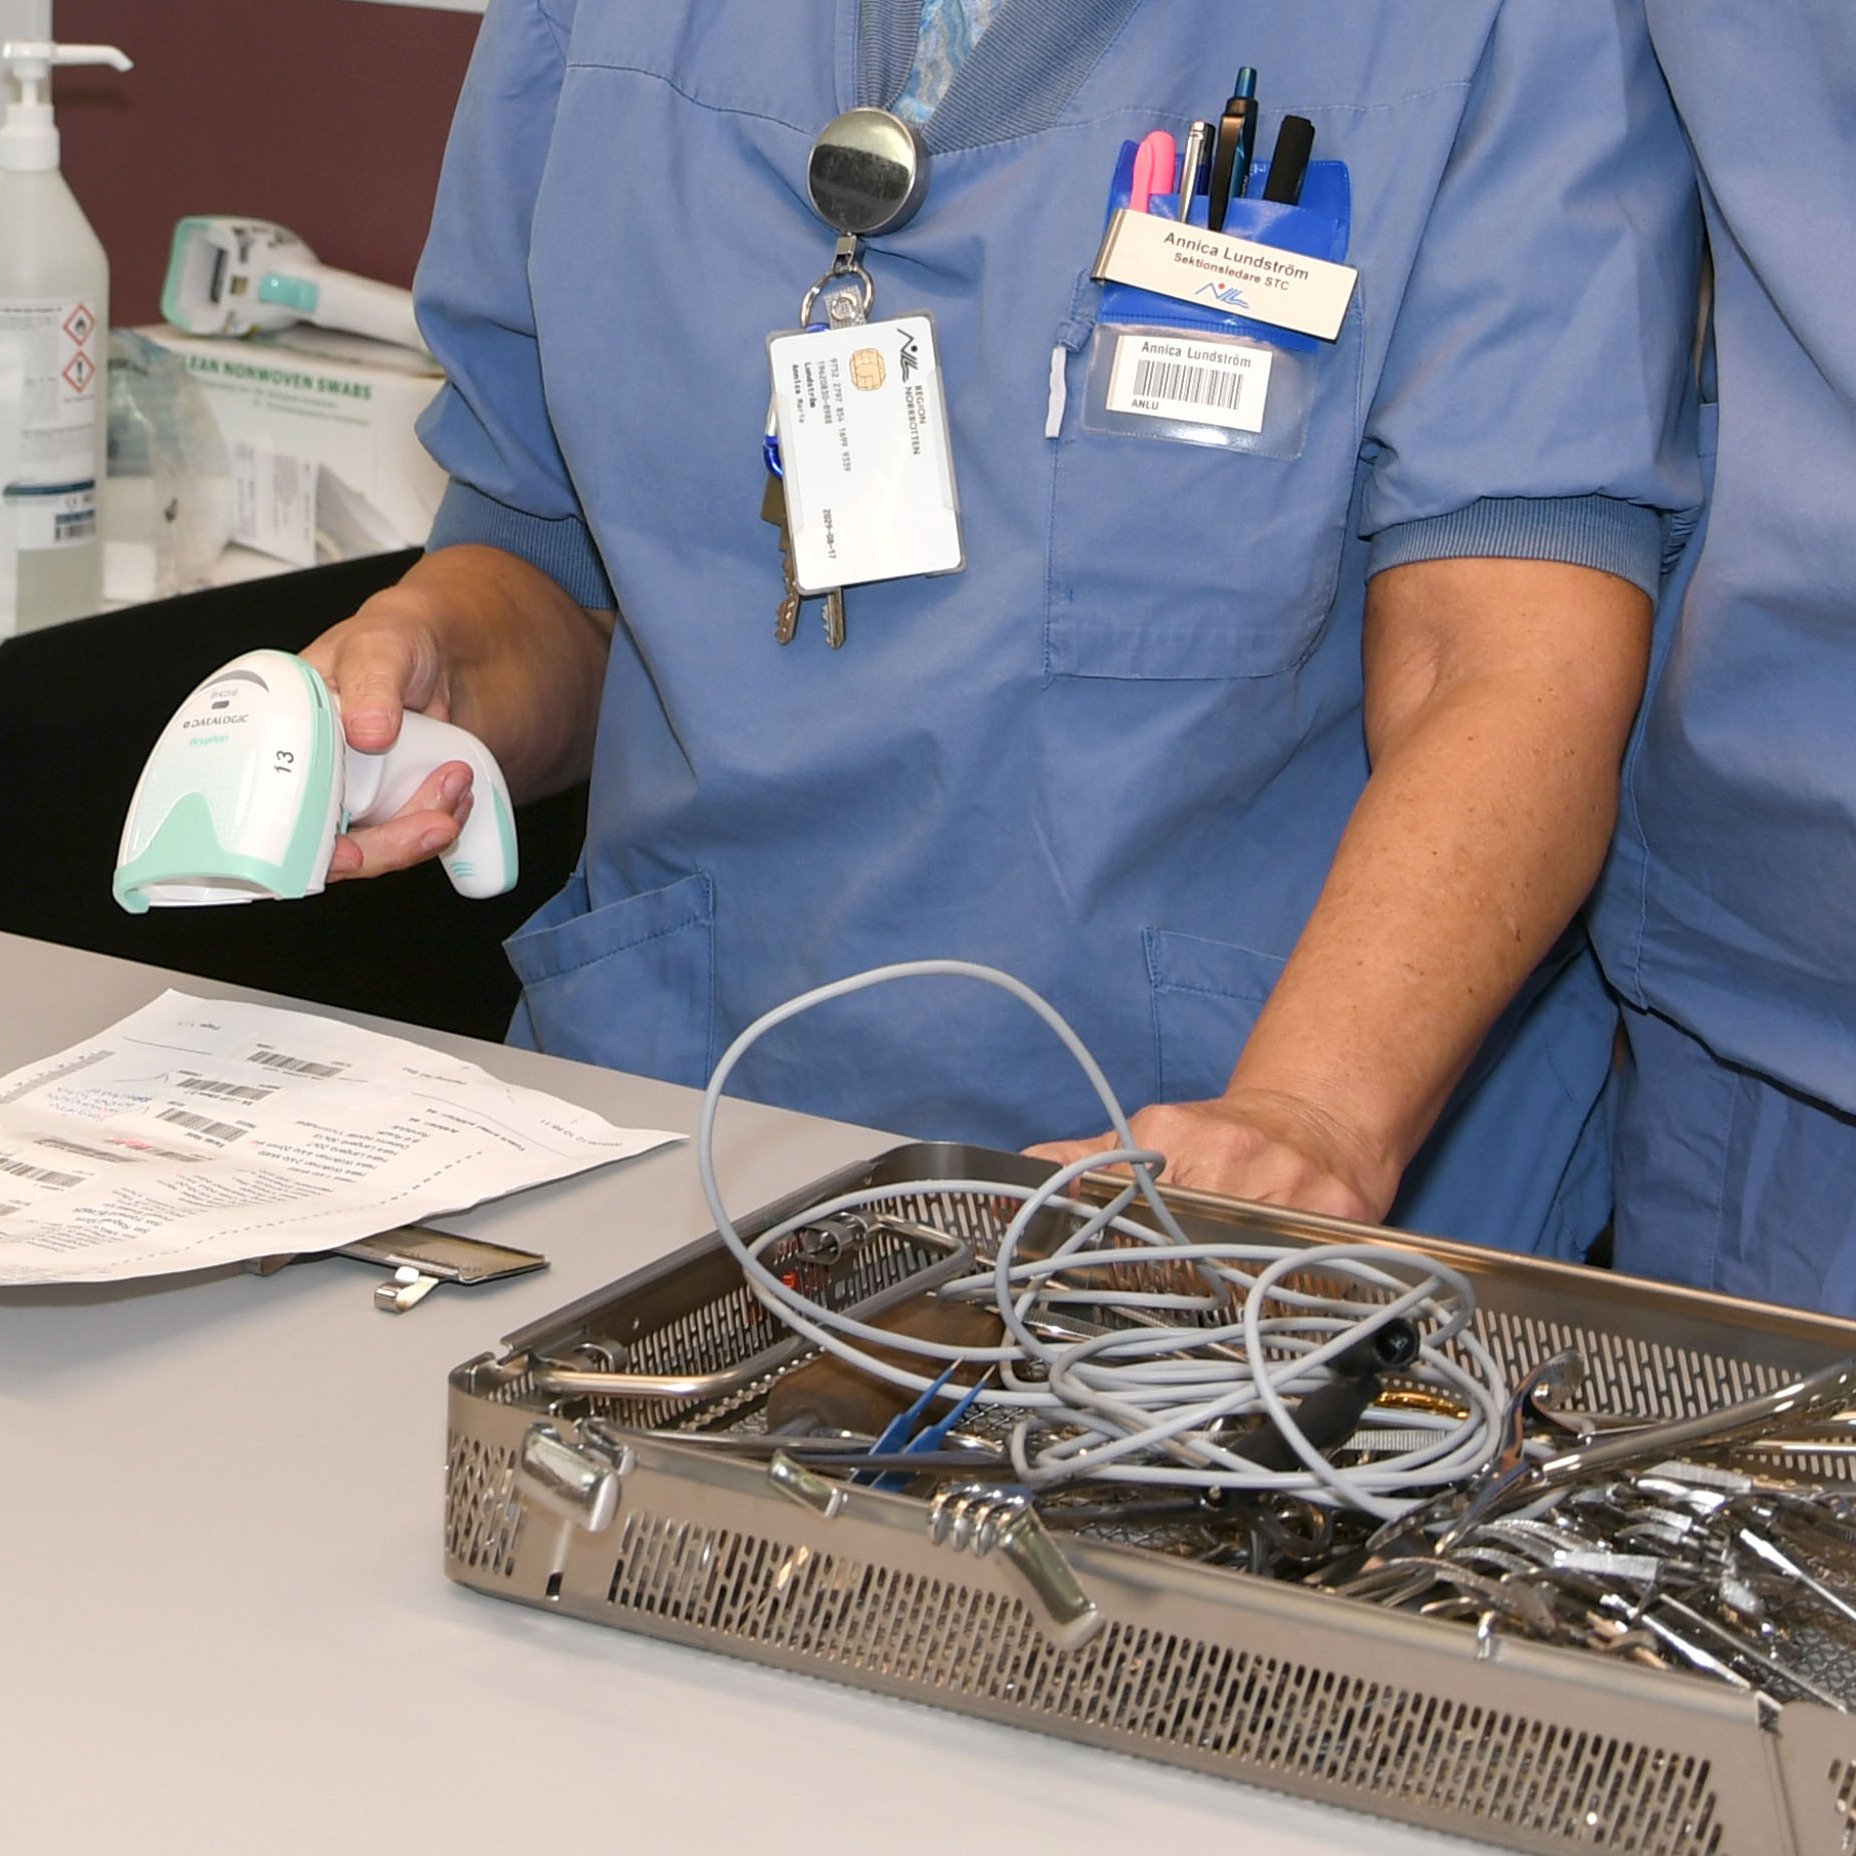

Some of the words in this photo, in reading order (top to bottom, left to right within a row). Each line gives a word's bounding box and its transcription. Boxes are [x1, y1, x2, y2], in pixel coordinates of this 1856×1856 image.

[1164, 232, 1218, 257] Annica
[1223, 247, 1310, 281] Lundström
[1173, 252, 1262, 284] Sektionsledare
[1264, 276, 1290, 291] STC
[1141, 341, 1182, 357] Annica
[1187, 344, 1252, 368] Lundström
[905, 387, 921, 454] NORRBOTTEN
[915, 386, 926, 424] REGION
[1131, 399, 1159, 411] ANLU
[274, 750, 295, 773] 13
